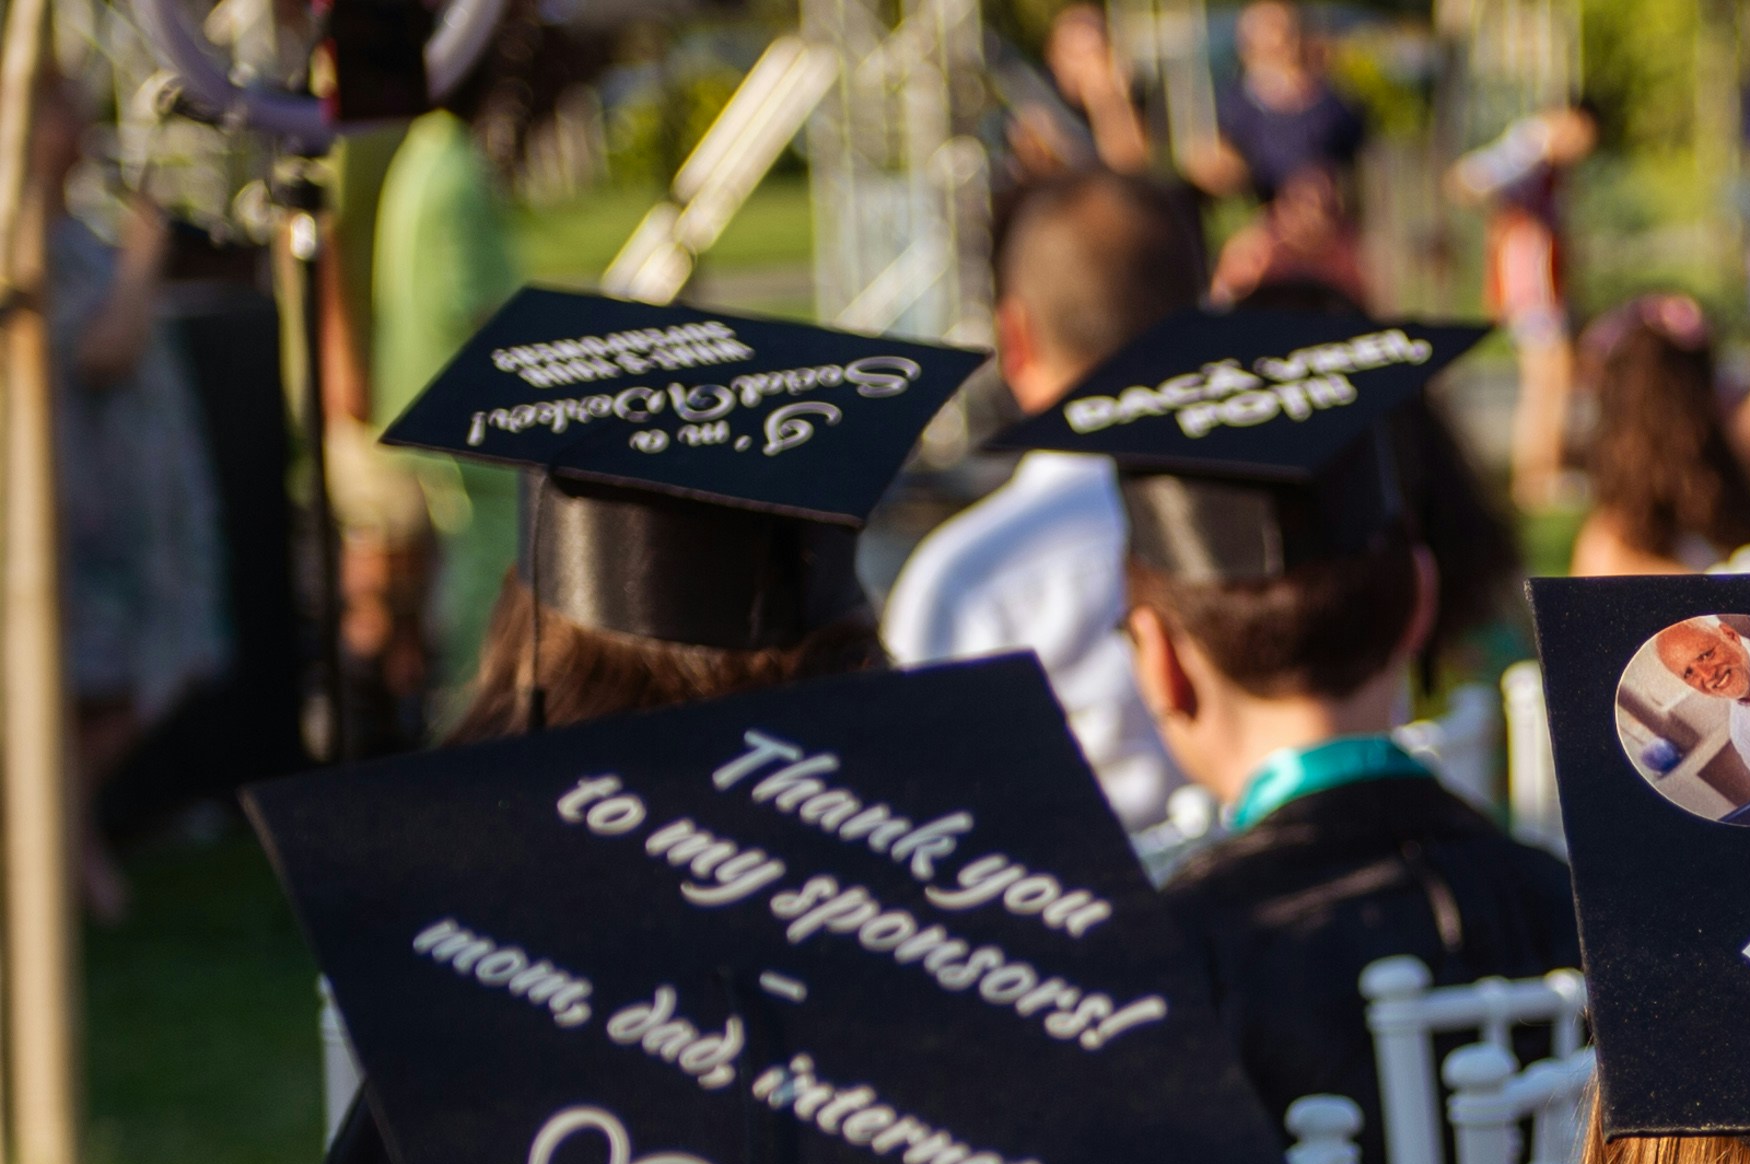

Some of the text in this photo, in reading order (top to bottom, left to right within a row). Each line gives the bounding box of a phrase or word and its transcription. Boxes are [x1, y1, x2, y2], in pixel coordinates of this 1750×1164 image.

[467, 354, 922, 447] Social Worker!
[630, 401, 842, 456] I'm a
[556, 772, 1169, 1052] to my sponsors!
[711, 729, 1114, 939] Thank you
[412, 918, 593, 1027] mom,
[605, 984, 746, 1090] dad,
